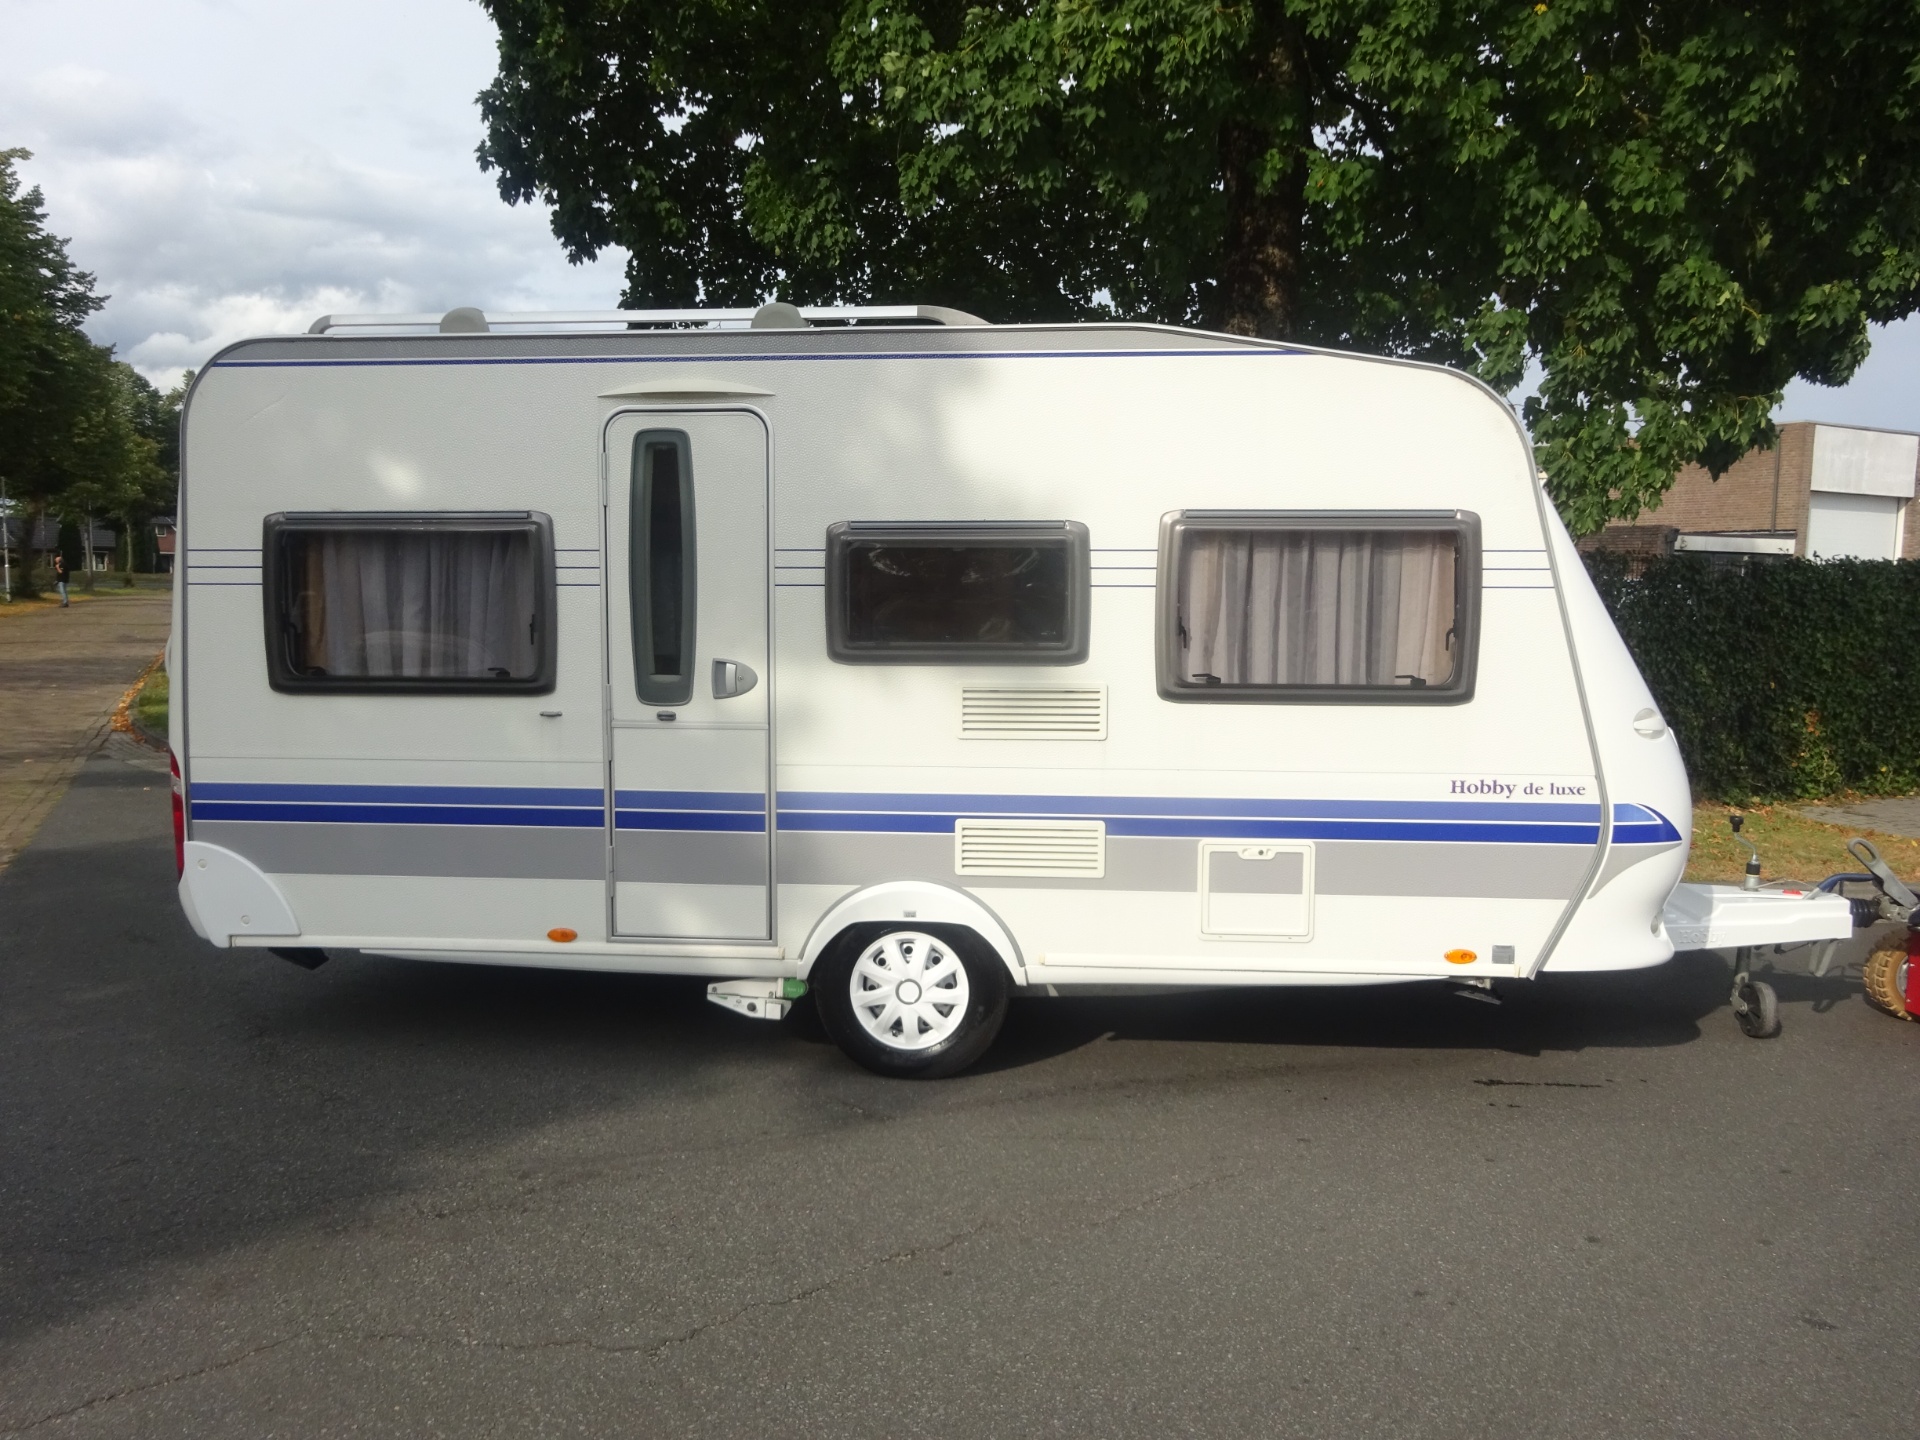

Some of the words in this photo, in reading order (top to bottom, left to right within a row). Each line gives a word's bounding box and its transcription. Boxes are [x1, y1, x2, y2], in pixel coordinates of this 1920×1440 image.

[1450, 779, 1517, 799] Hobby
[1523, 782, 1544, 795] de
[1549, 782, 1586, 796] luxe
[1679, 928, 1727, 947] Hobby
